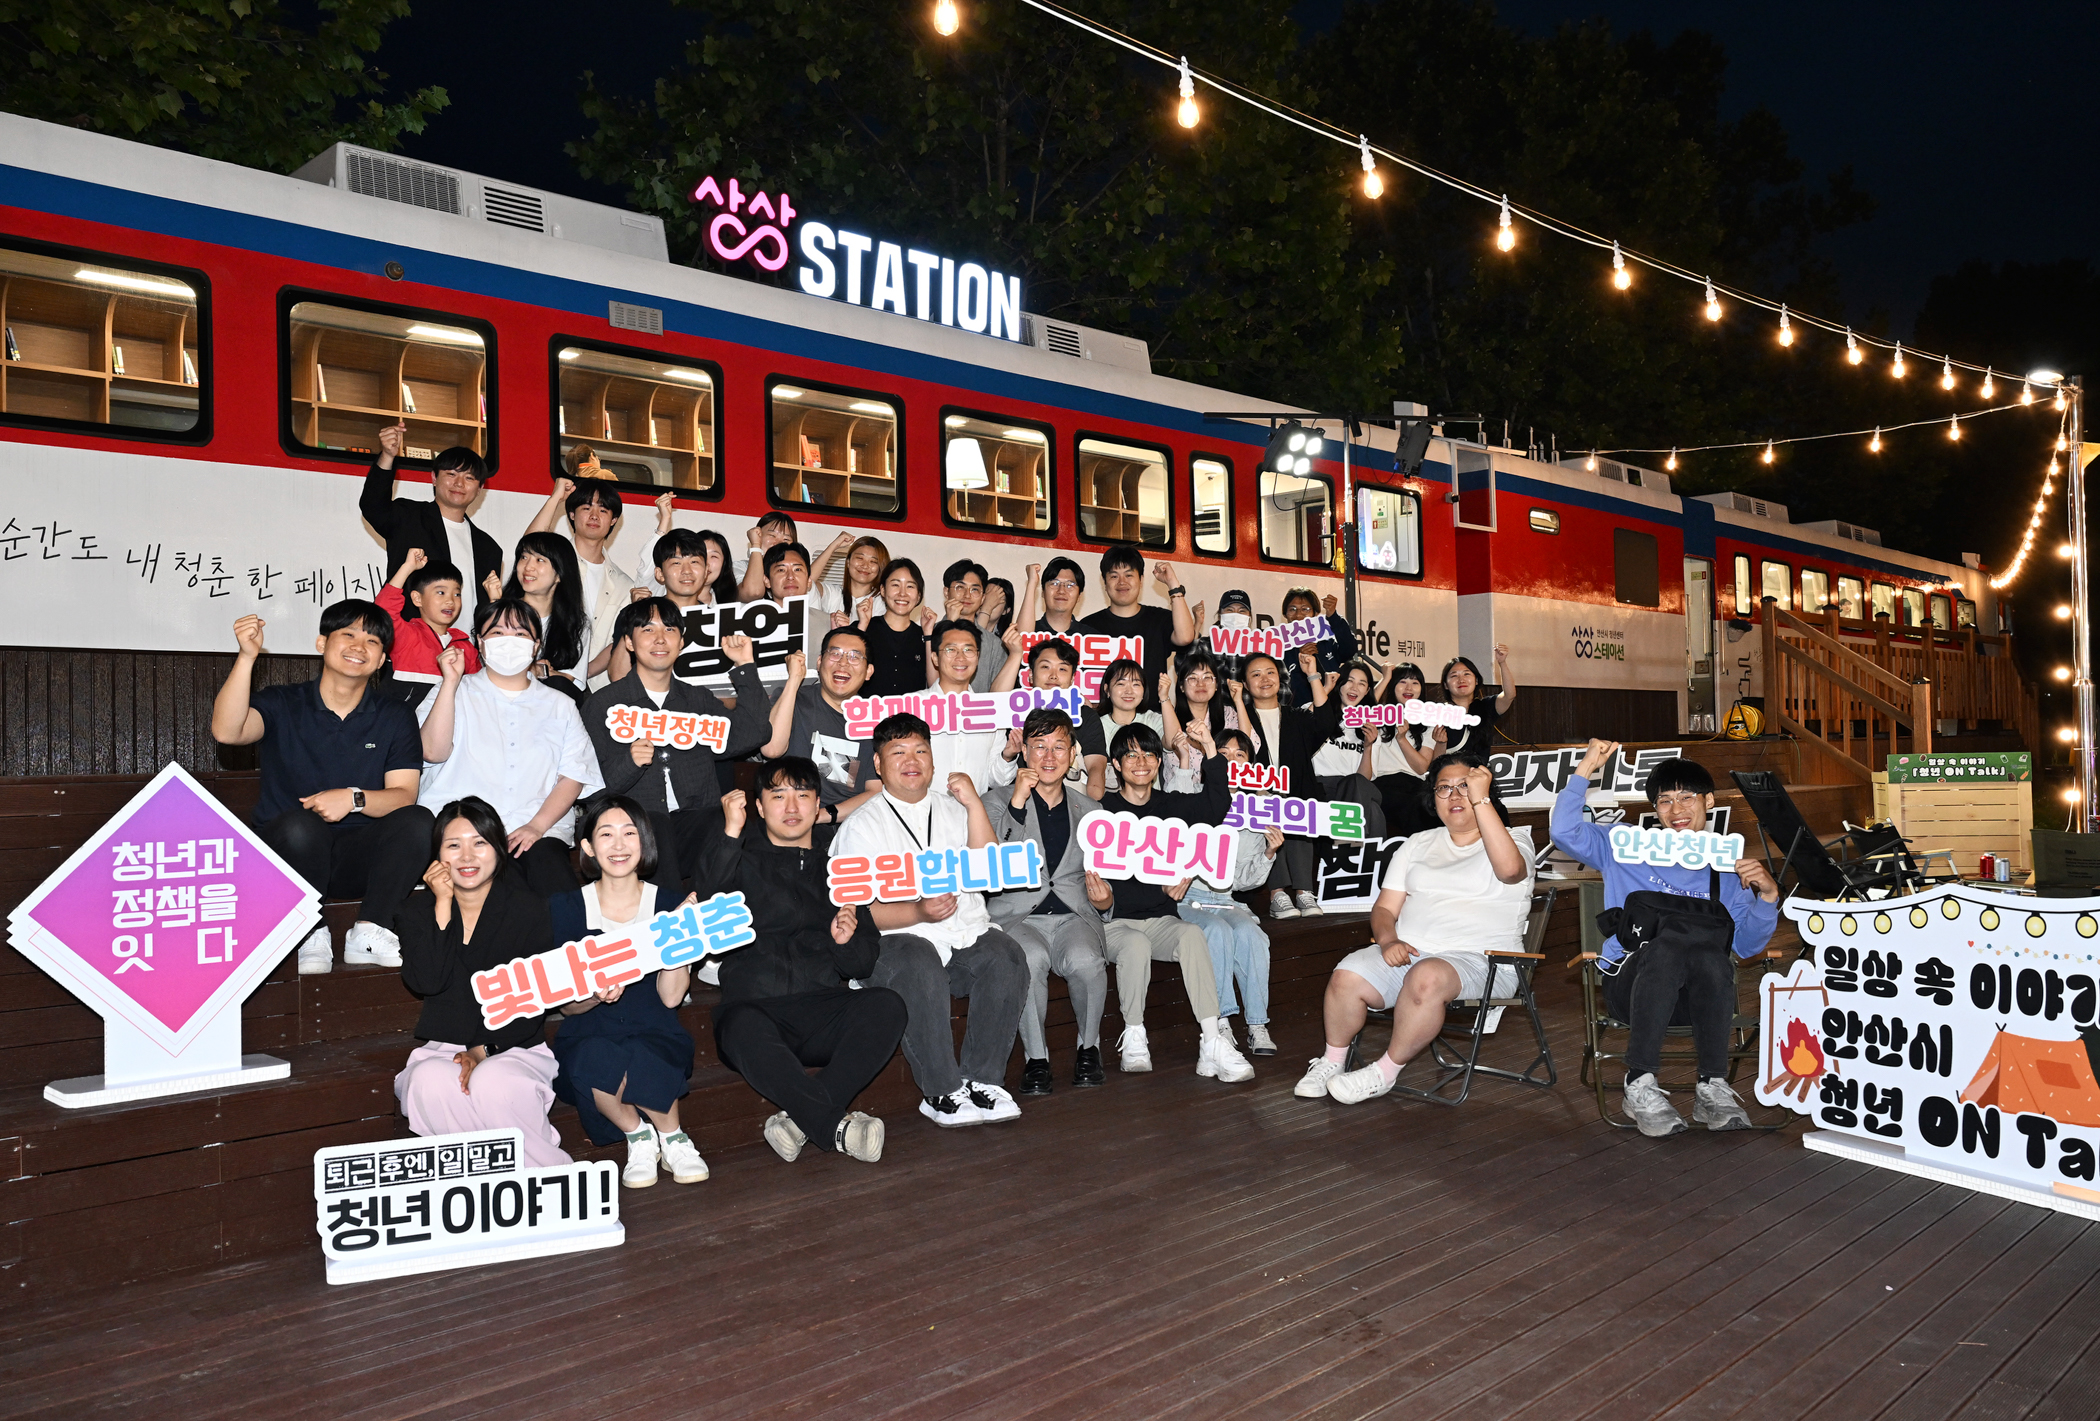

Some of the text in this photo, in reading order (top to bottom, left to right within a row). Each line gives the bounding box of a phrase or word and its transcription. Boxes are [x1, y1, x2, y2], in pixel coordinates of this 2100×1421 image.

[799, 221, 1021, 342] STATION
[0, 517, 108, 561] 순간도
[126, 543, 161, 583] 내
[174, 551, 234, 598] 청춘
[246, 564, 282, 600] 한
[673, 600, 805, 678] 창업
[1211, 627, 1283, 658] With
[1355, 620, 1391, 657] afe
[1397, 639, 1426, 658] 북카페
[1593, 642, 1625, 661] 스테이션
[610, 708, 727, 750] 청년정책
[1009, 688, 1082, 728] 안산
[1344, 700, 1480, 727] 청년이 응원해~
[1494, 751, 1617, 797] 일자리
[1944, 766, 1964, 776] ON
[1329, 803, 1363, 838] 꿈
[111, 837, 240, 882] 청년과
[829, 840, 1041, 904] 응원합니다
[1086, 819, 1231, 881] 안산시
[1612, 830, 1739, 868] 안산청년
[111, 882, 239, 929] 정책을
[111, 925, 239, 975] 잇 다
[475, 894, 753, 1027] 빛나는 청춘
[1823, 945, 1903, 998] 일상
[1914, 957, 1956, 1006] 속
[1821, 1007, 1954, 1078] 안산시
[1819, 1073, 2100, 1182] 청년 ON Ta
[325, 1143, 516, 1188] 퇴근 후엔, 일 말고
[327, 1188, 432, 1253] 청년
